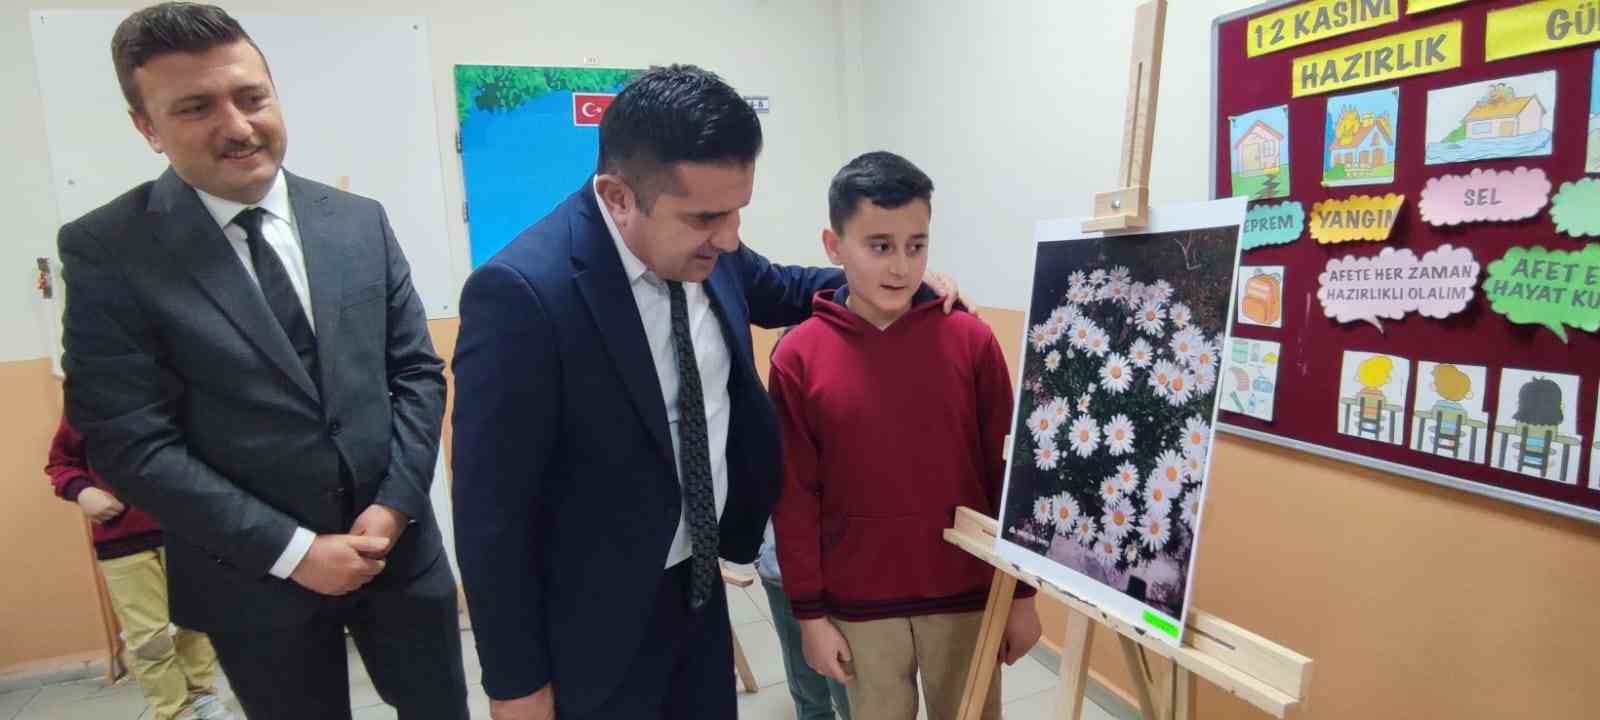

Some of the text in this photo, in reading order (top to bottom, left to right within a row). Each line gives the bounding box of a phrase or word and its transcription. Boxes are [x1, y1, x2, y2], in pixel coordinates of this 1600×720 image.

[1294, 0, 1391, 39] KASIM
[1546, 2, 1600, 41] GÜ
[1301, 34, 1447, 89] HAZIRLIK
[1463, 187, 1504, 207] SEL
[1329, 265, 1472, 282] AFETE HER ZAMAN
[1510, 257, 1579, 282] AFET
[1326, 286, 1467, 300] HAZIRLIKLI OLALIM
[1493, 279, 1567, 304] HAYAT
